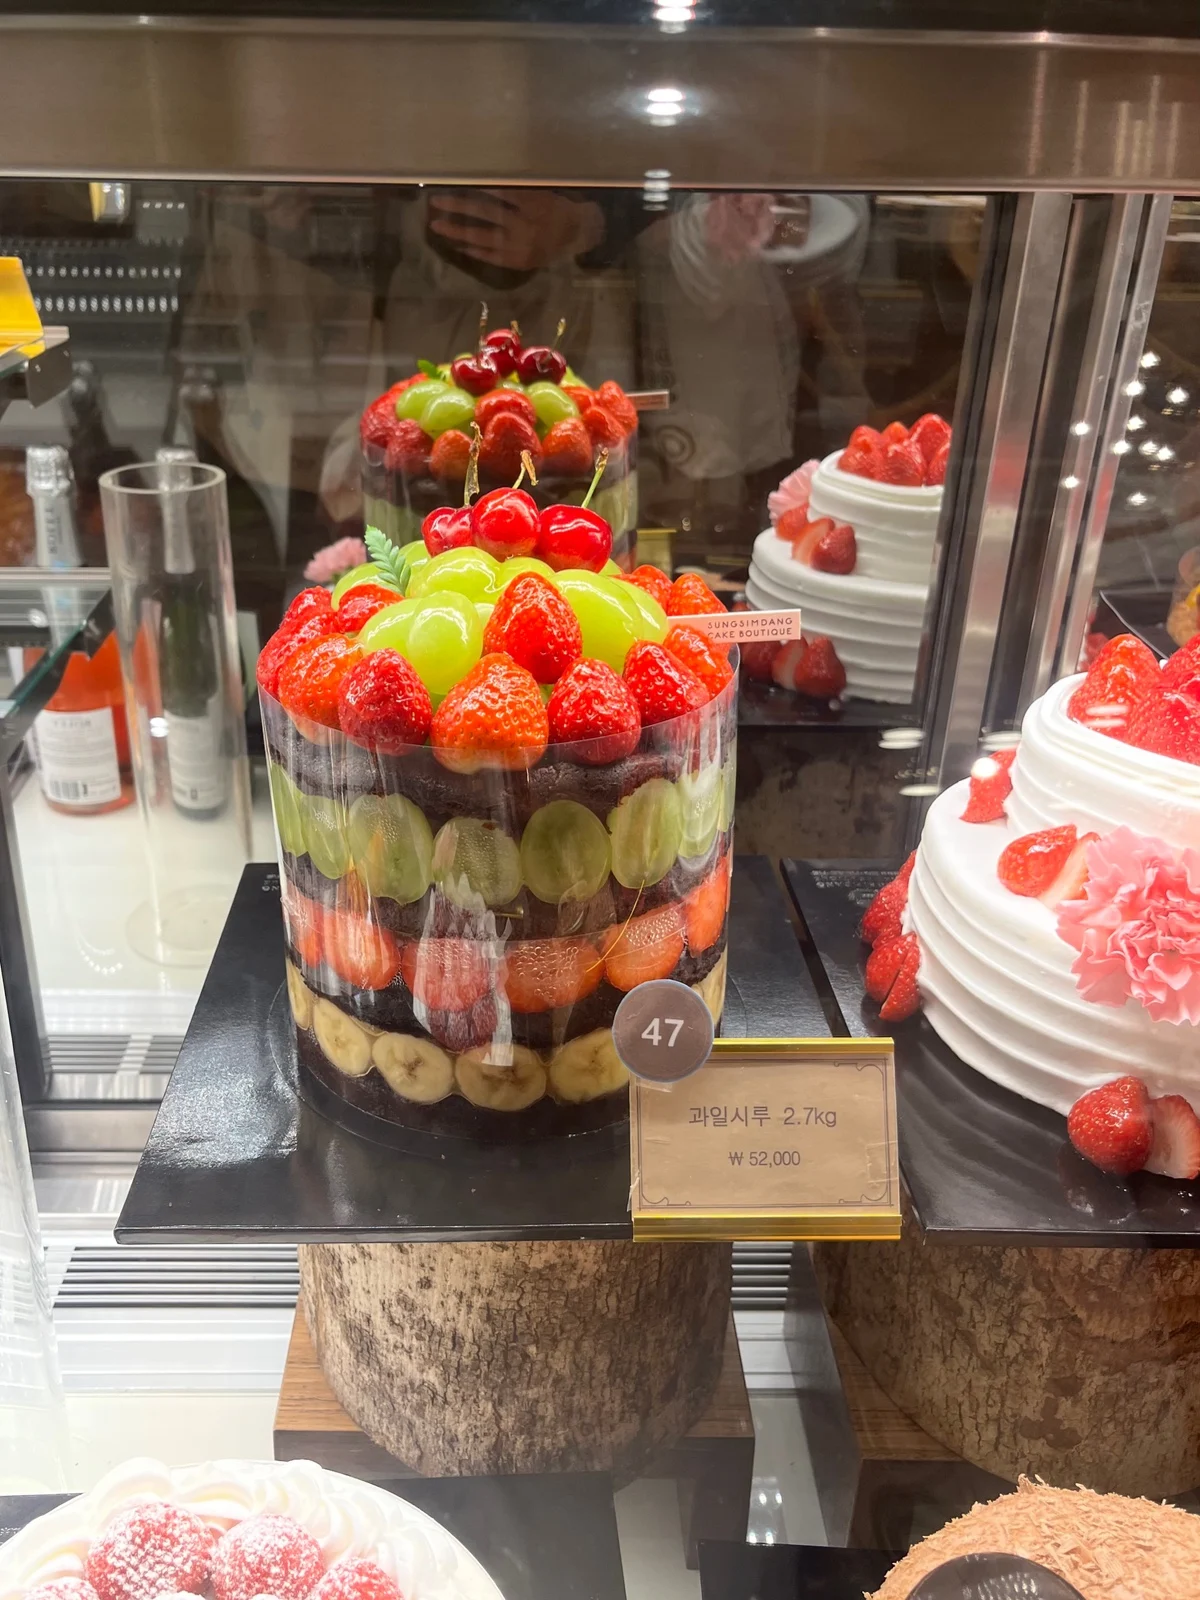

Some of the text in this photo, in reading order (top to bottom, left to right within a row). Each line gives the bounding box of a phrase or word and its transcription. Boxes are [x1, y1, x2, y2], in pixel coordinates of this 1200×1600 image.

[707, 617, 793, 629] SUNGSIMDANG
[707, 627, 792, 639] CAKE BOUTIQUE
[641, 1017, 685, 1047] 47
[688, 1105, 837, 1128] 과일시루 2.7kg
[749, 1150, 801, 1168] 52,000
